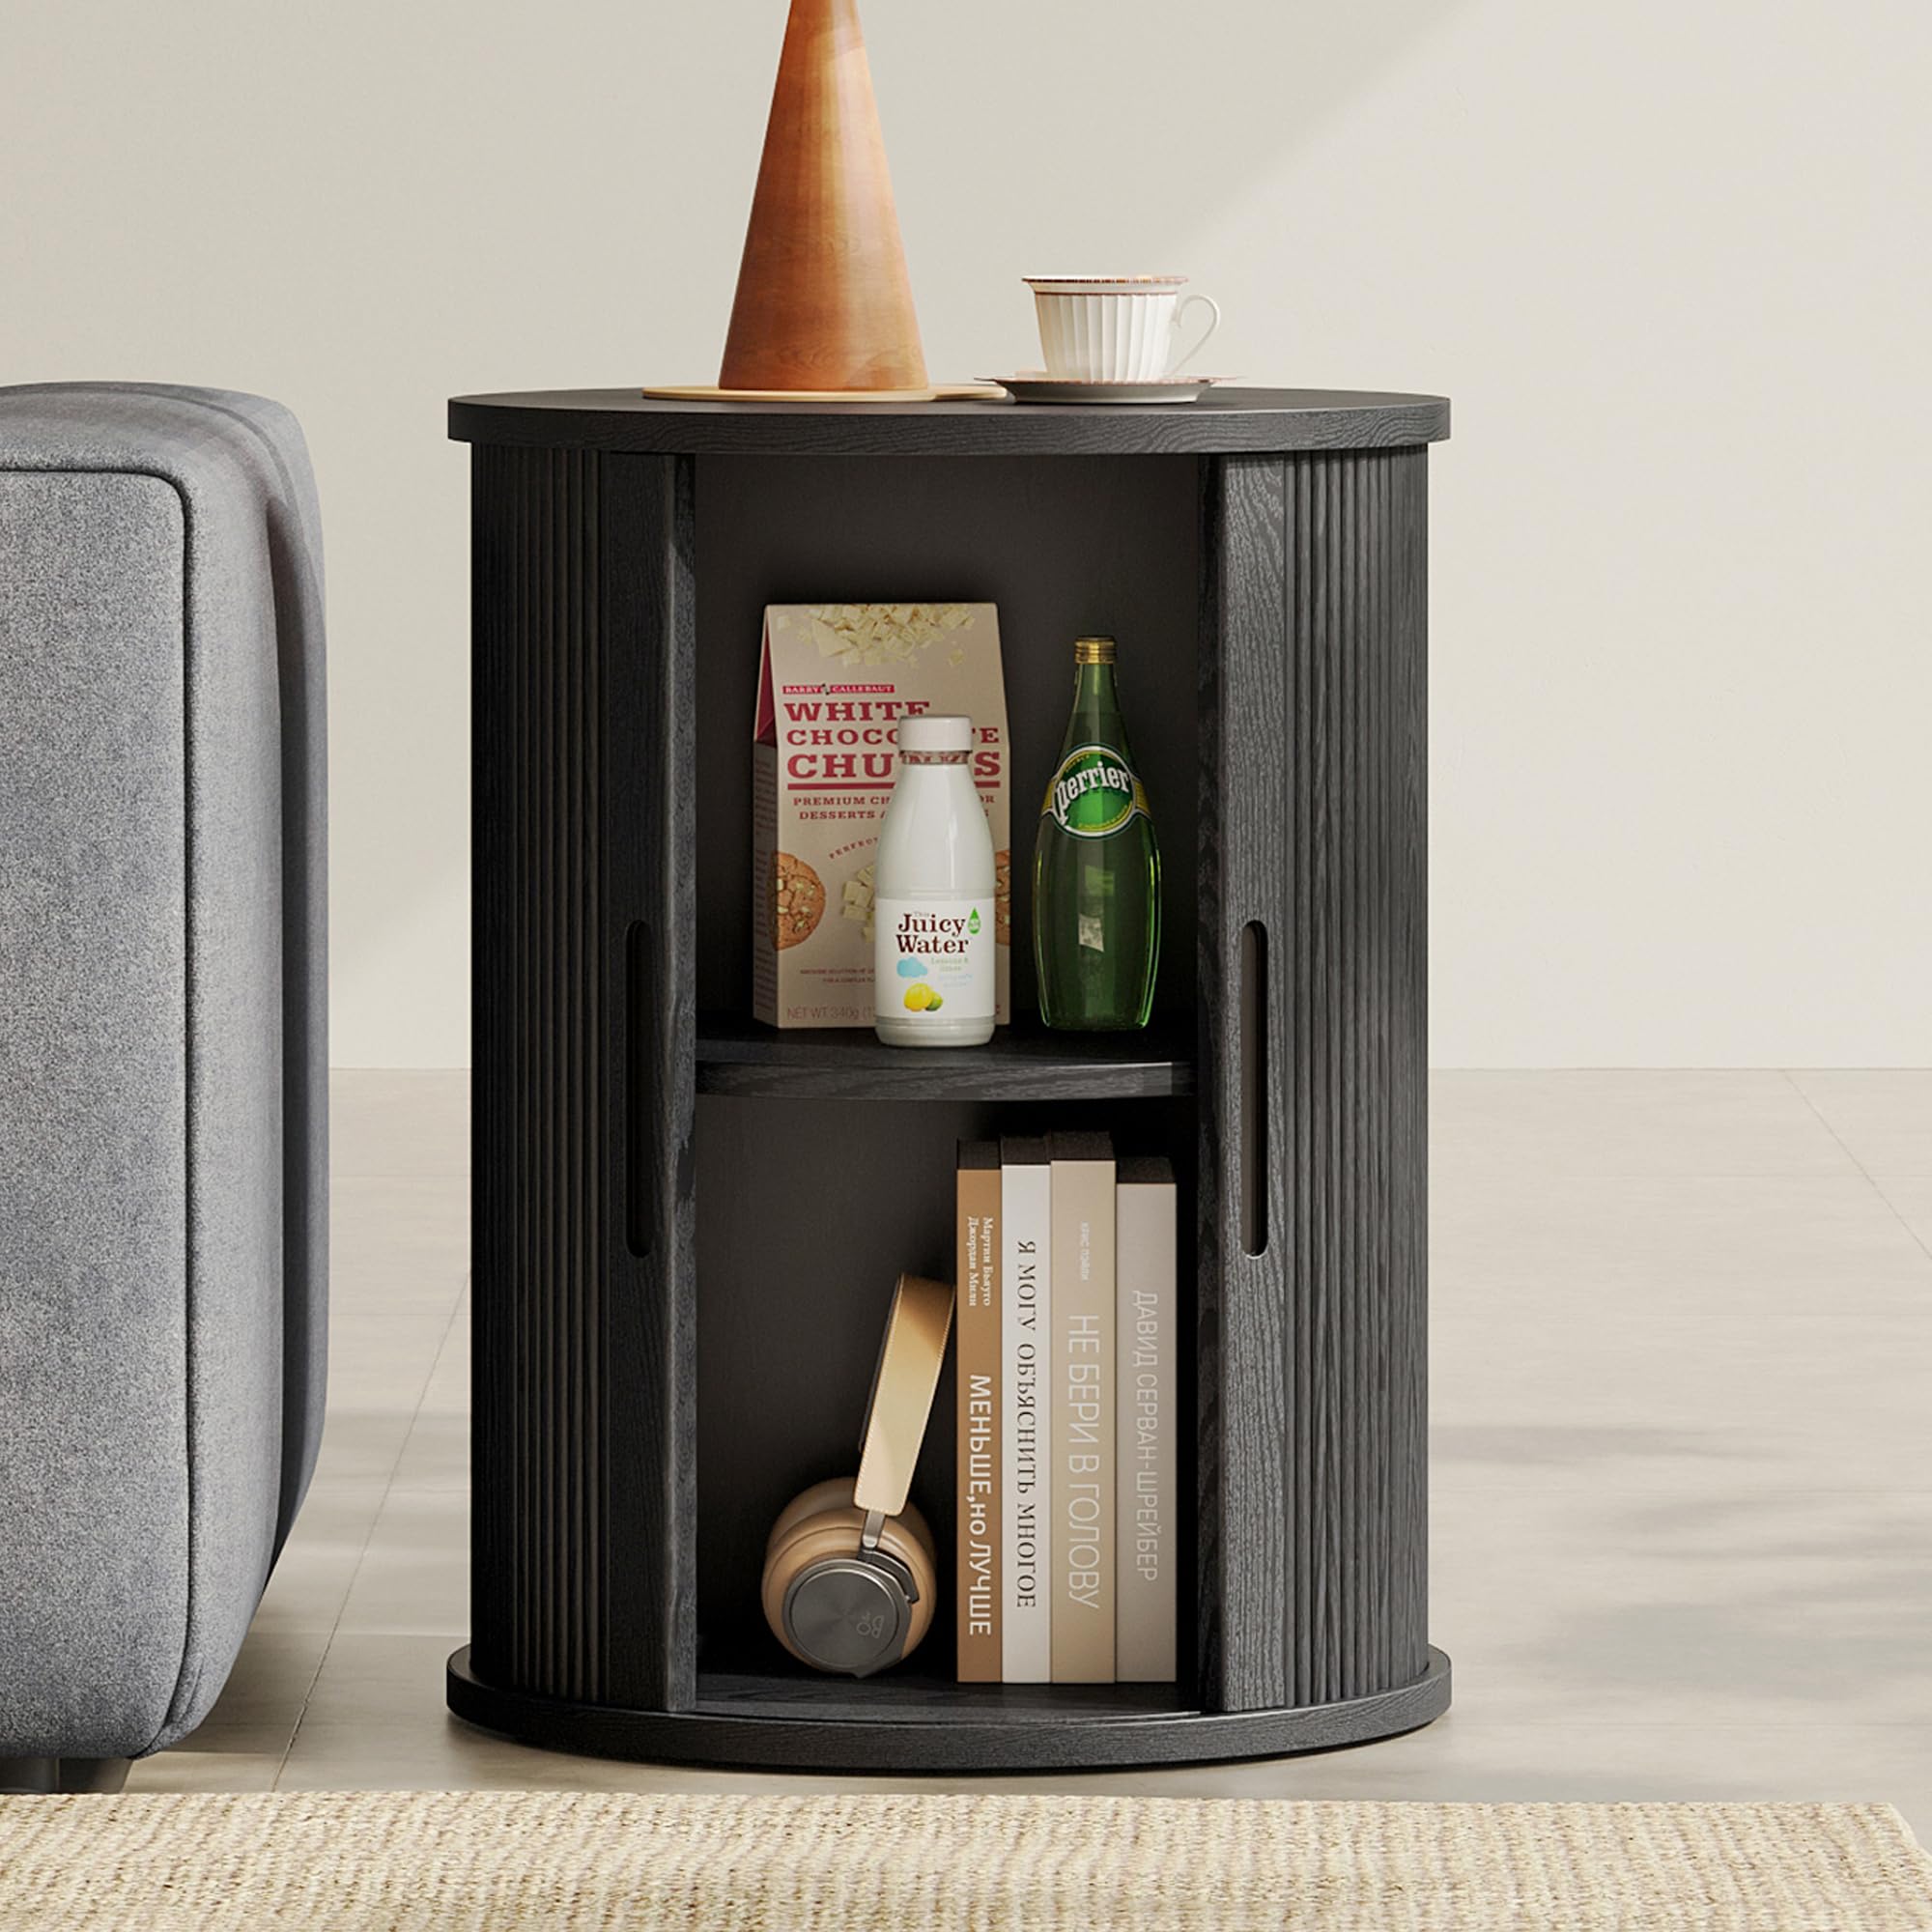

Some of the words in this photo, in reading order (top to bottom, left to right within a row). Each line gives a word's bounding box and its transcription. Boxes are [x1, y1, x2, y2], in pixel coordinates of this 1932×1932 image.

[783, 701, 929, 721] WHITE
[787, 751, 1001, 779] CHUS
[793, 796, 866, 806] PREMIUM
[800, 810, 876, 820] DESSERTS
[895, 934, 969, 953] Water
[898, 913, 966, 937] Juicy
[1017, 1241, 1036, 1254] Я
[1017, 1264, 1037, 1330] МОГУ
[1068, 1314, 1099, 1353] НЕ
[1133, 1291, 1158, 1368] ДАВИД
[1017, 1343, 1037, 1494] ОБЪЯСНИТЬ
[1068, 1364, 1099, 1443] БЕРИ
[1068, 1454, 1099, 1473] В
[1136, 1375, 1162, 1581] СЕРВАН-ШРЕЙБЕР
[1017, 1503, 1037, 1607] МНОГОЕ
[1068, 1483, 1099, 1609] ГОЛОВУ
[969, 1540, 991, 1635] ЛУЧШЕ
